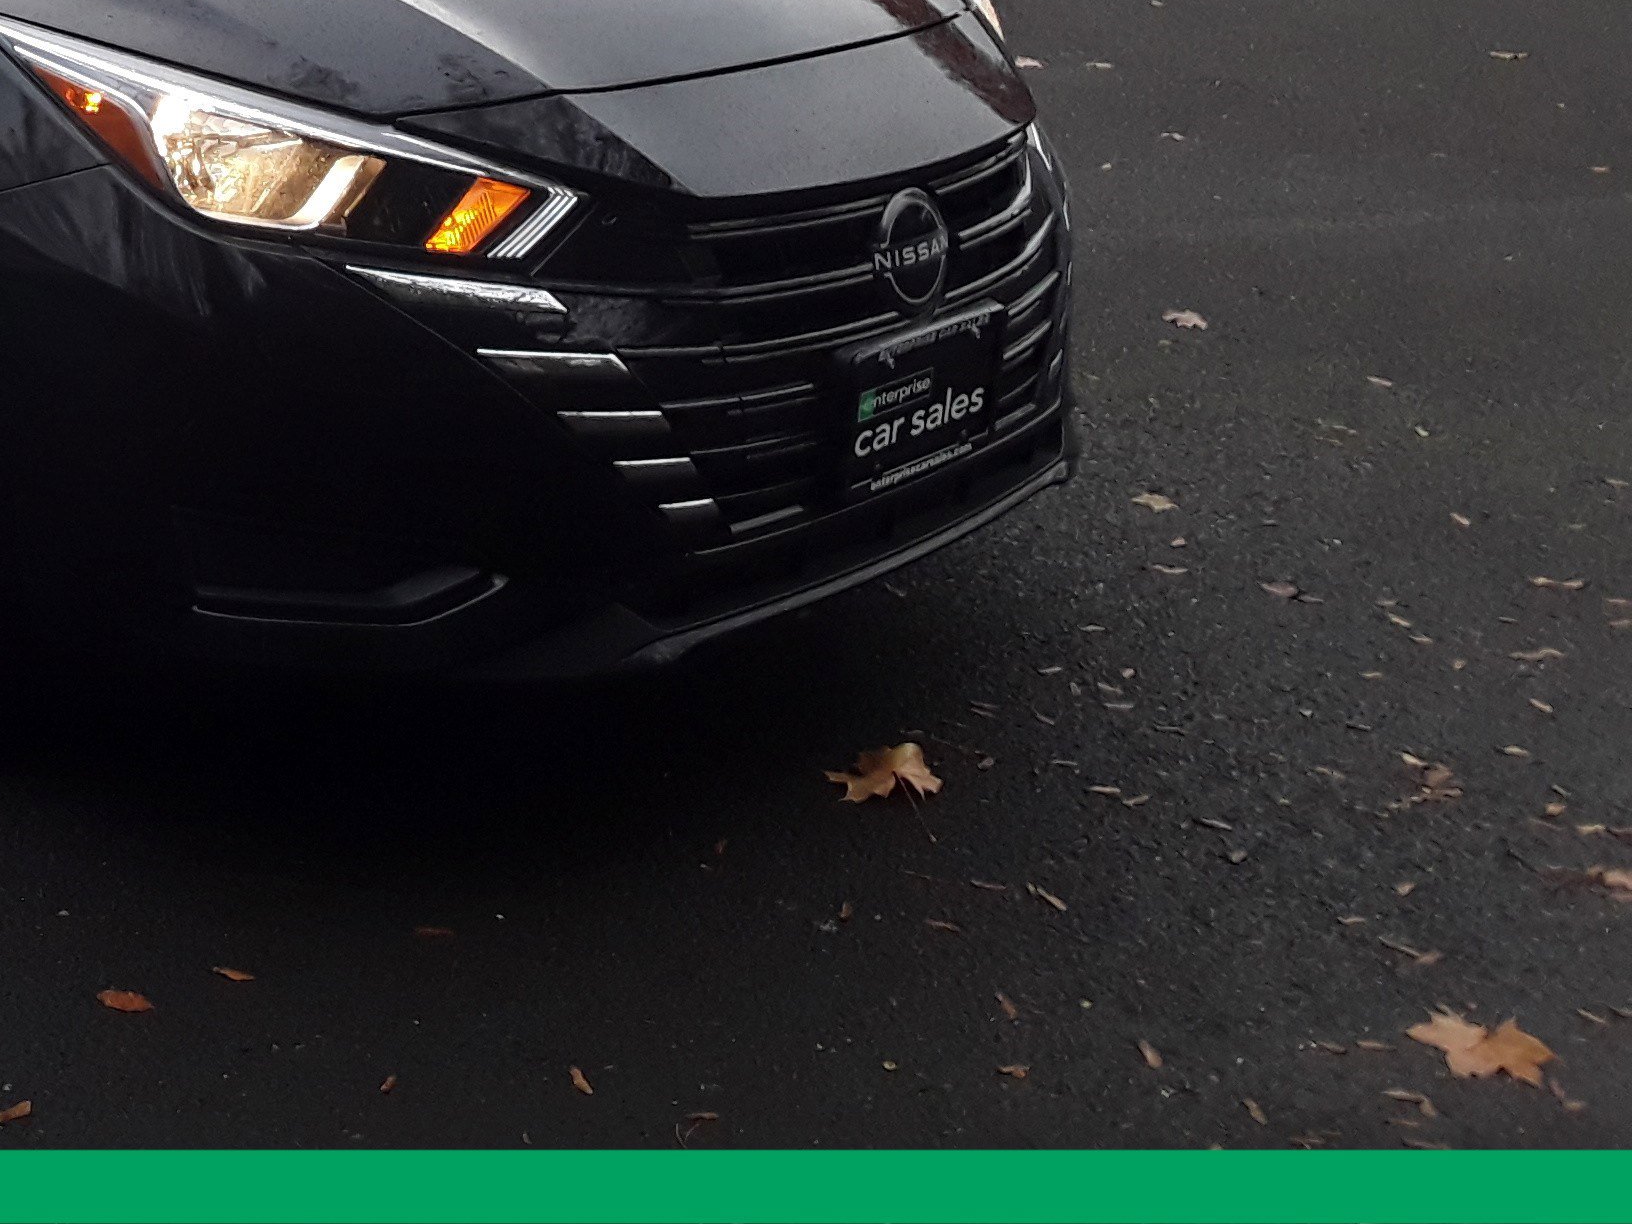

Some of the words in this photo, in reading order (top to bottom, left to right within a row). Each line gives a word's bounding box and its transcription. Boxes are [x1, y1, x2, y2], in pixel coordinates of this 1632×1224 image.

[873, 235, 949, 271] NISSAN
[854, 416, 905, 458] car
[909, 386, 986, 437] sales
